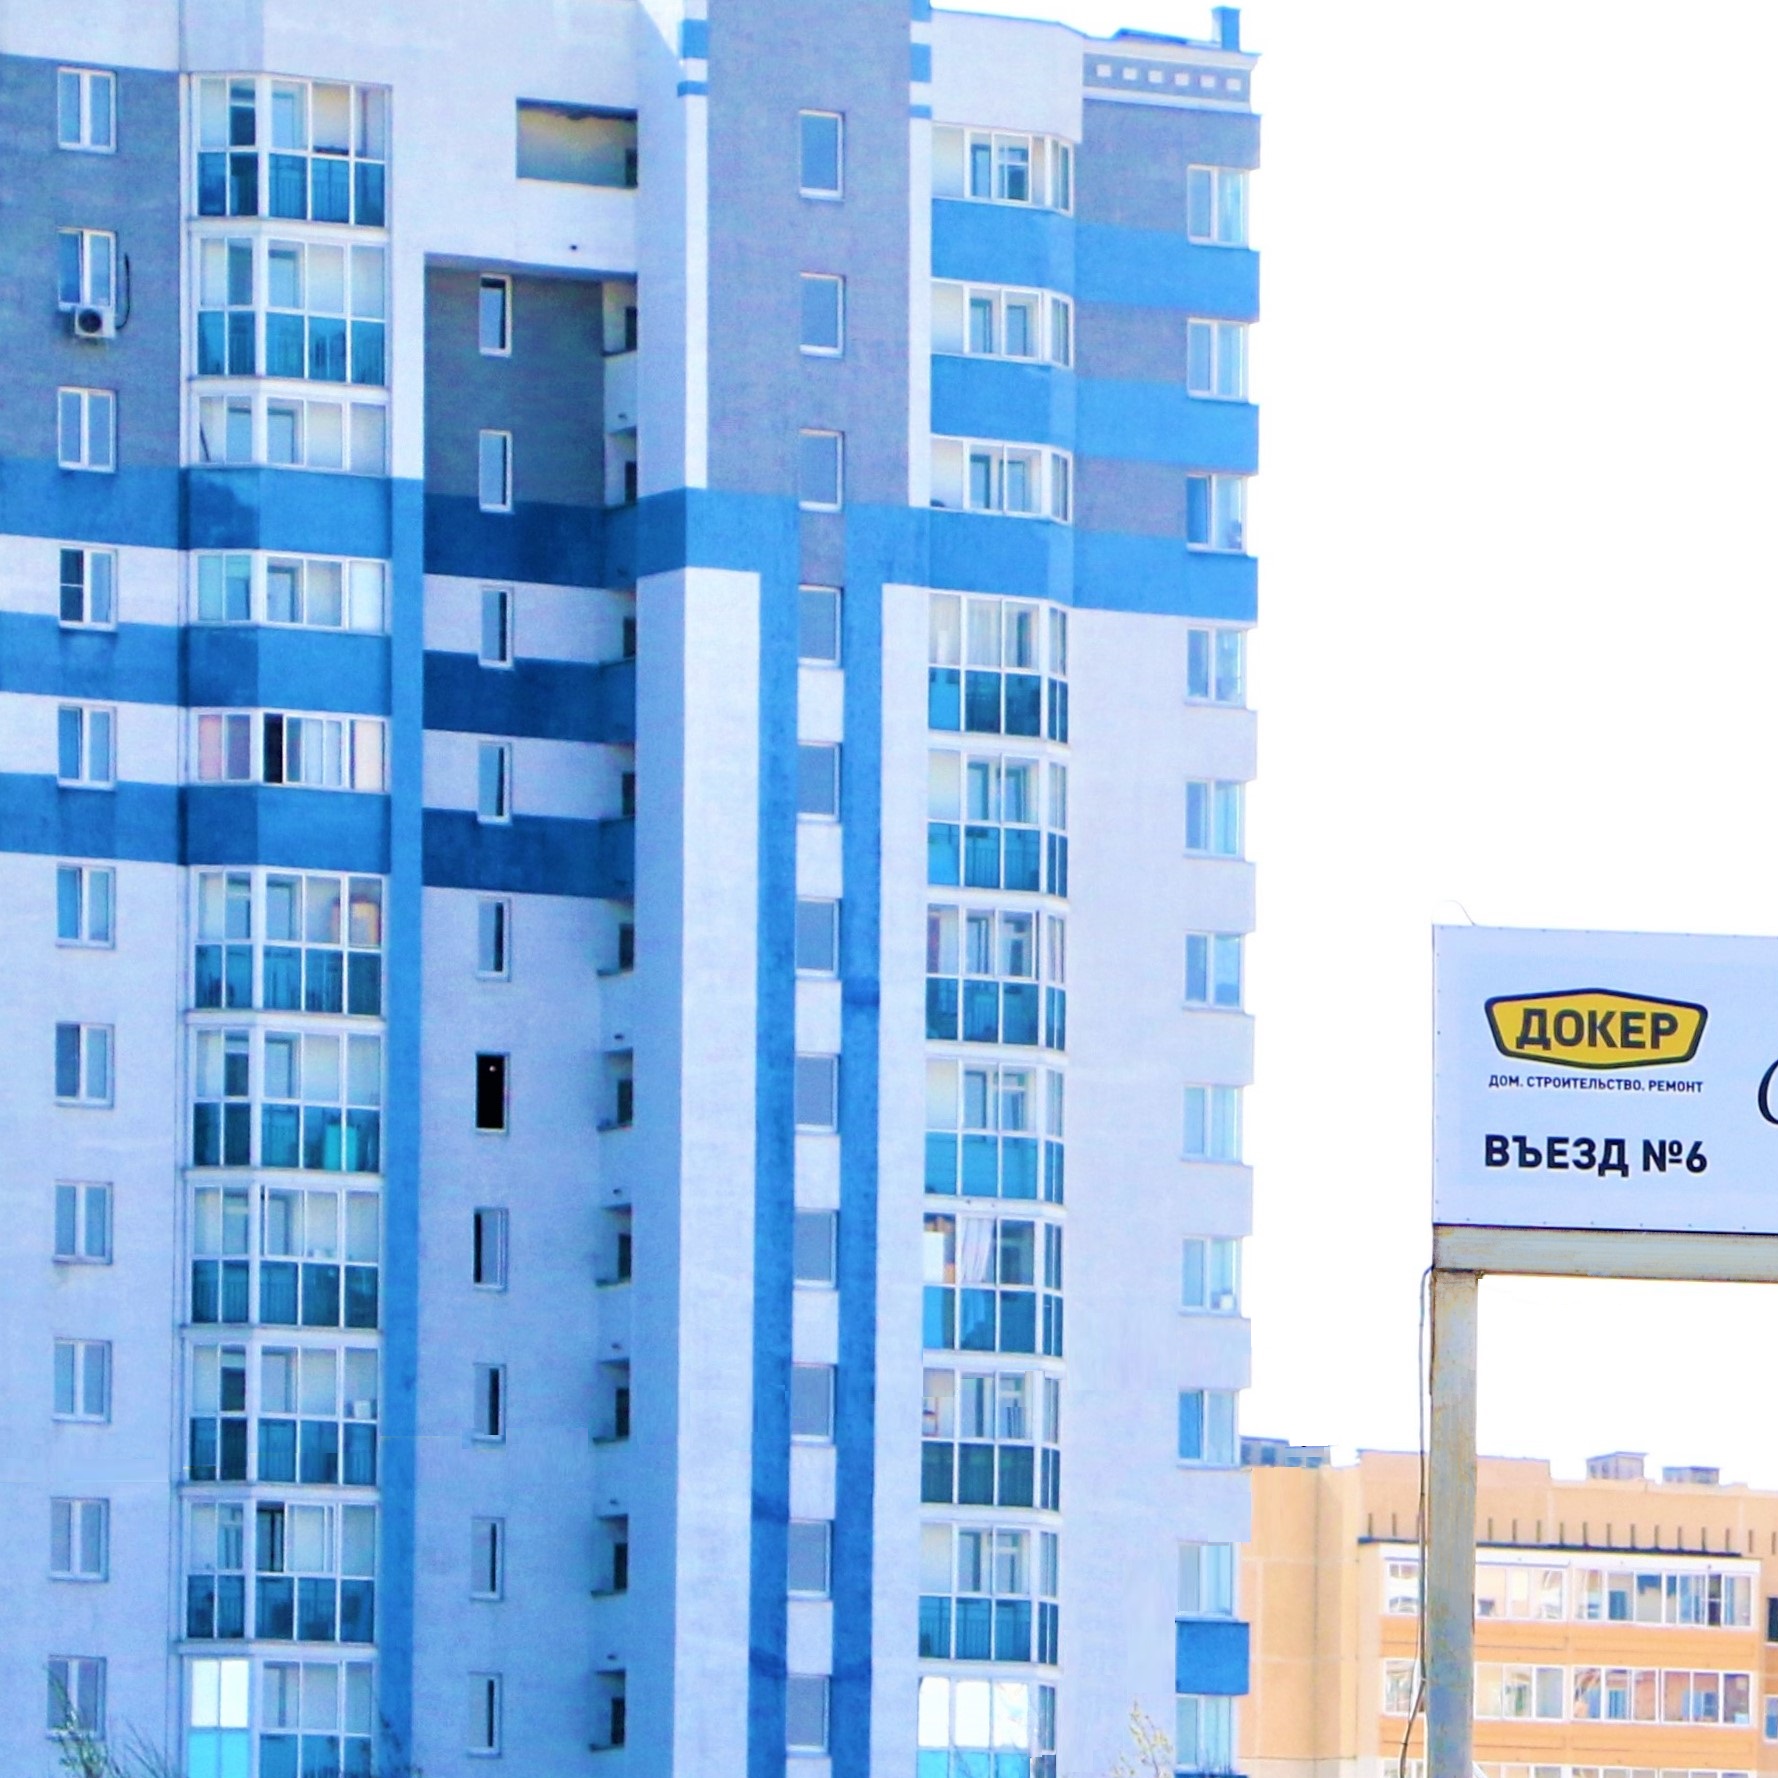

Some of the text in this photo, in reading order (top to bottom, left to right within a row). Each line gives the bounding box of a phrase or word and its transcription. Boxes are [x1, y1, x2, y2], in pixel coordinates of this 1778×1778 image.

[1515, 1008, 1679, 1051] ДОКЕР
[1488, 1075, 1704, 1093] ДОМ. СТРОИТЕЛЬСТВО. РЕМОНТ
[1485, 1134, 1708, 1178] ВЪЕЗД №6
